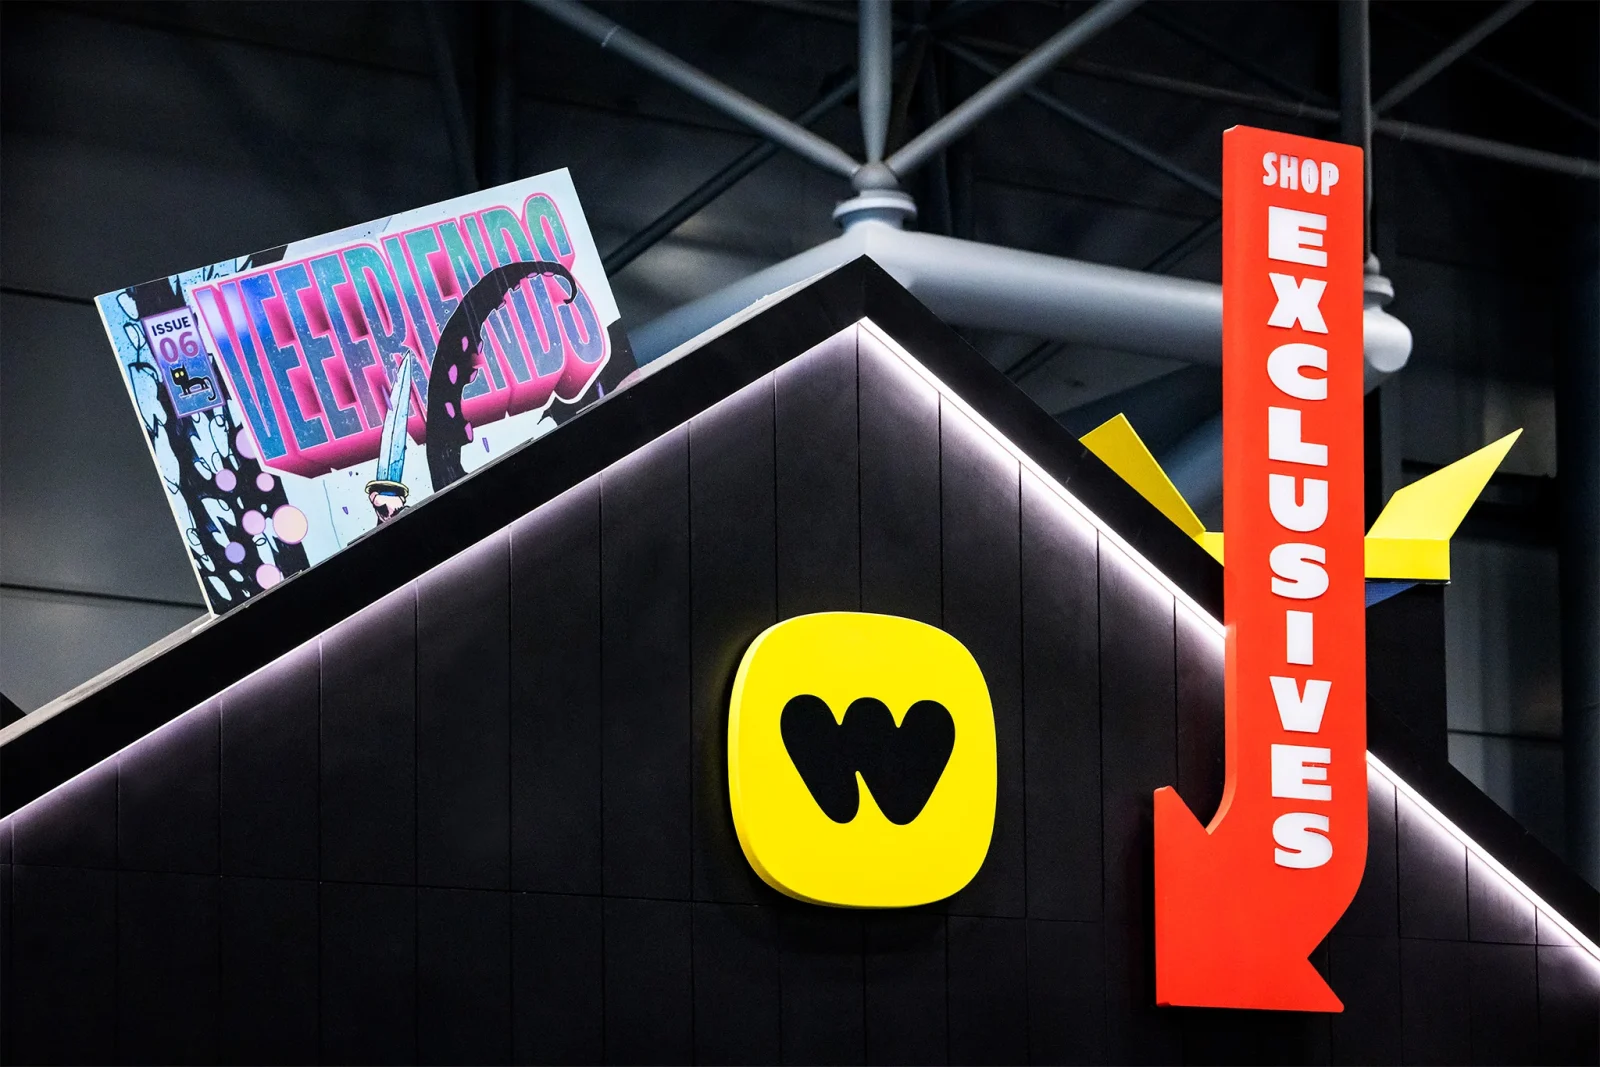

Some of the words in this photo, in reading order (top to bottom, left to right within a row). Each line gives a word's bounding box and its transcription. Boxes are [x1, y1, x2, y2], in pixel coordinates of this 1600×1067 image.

[1262, 152, 1340, 196] SHOP
[151, 316, 192, 337] ISSUE
[159, 331, 199, 363] 06
[193, 192, 606, 468] VEEFRIENDS
[1267, 205, 1333, 869] EXCLUSIVES
